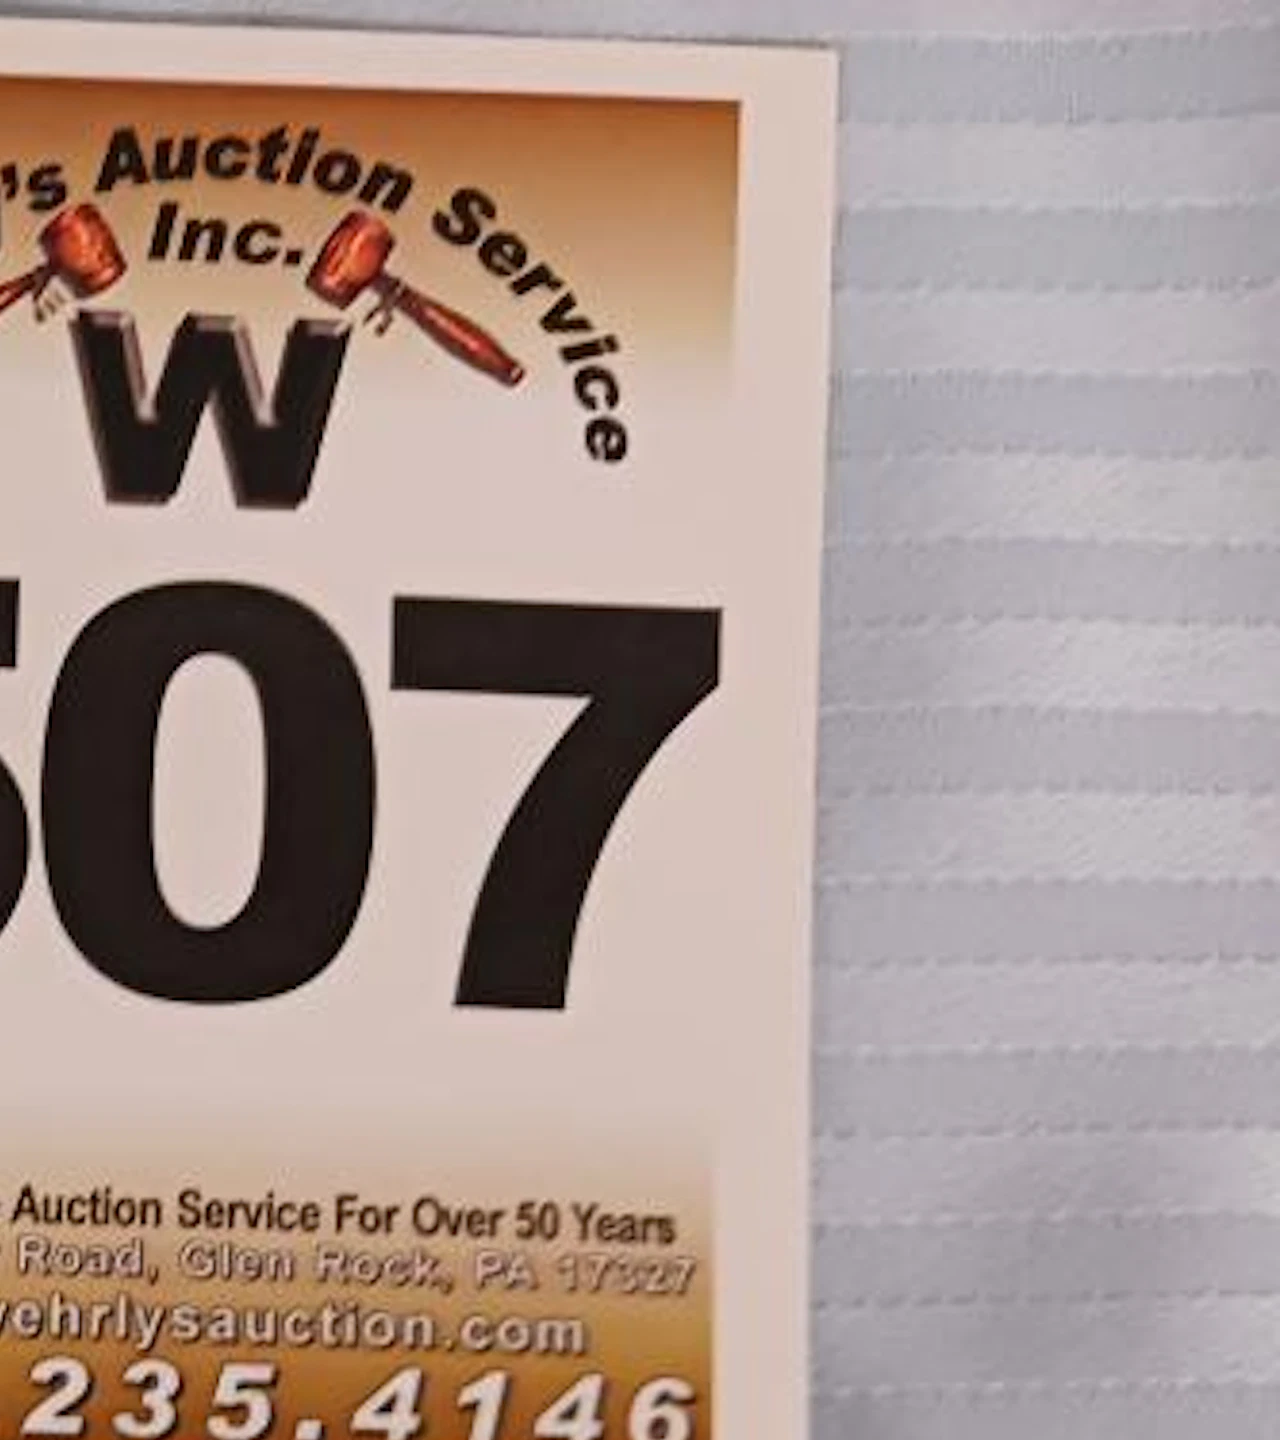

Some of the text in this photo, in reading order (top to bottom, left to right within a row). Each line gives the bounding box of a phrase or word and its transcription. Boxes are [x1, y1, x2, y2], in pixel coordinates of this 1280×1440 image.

[147, 201, 304, 268] Inc.
[94, 125, 414, 213] Auction
[431, 187, 628, 464] Service
[70, 308, 351, 512] W
[12, 1185, 162, 1229] Auction
[177, 1188, 320, 1231] Service
[334, 1195, 396, 1235] For
[412, 1198, 505, 1239] Over
[516, 1201, 558, 1241] 50
[571, 1203, 677, 1245] Years
[17, 1233, 160, 1286] Road,
[178, 1238, 294, 1281] Glen
[315, 1244, 456, 1294] Rock,
[474, 1250, 540, 1292] PA
[557, 1253, 697, 1296] 17327
